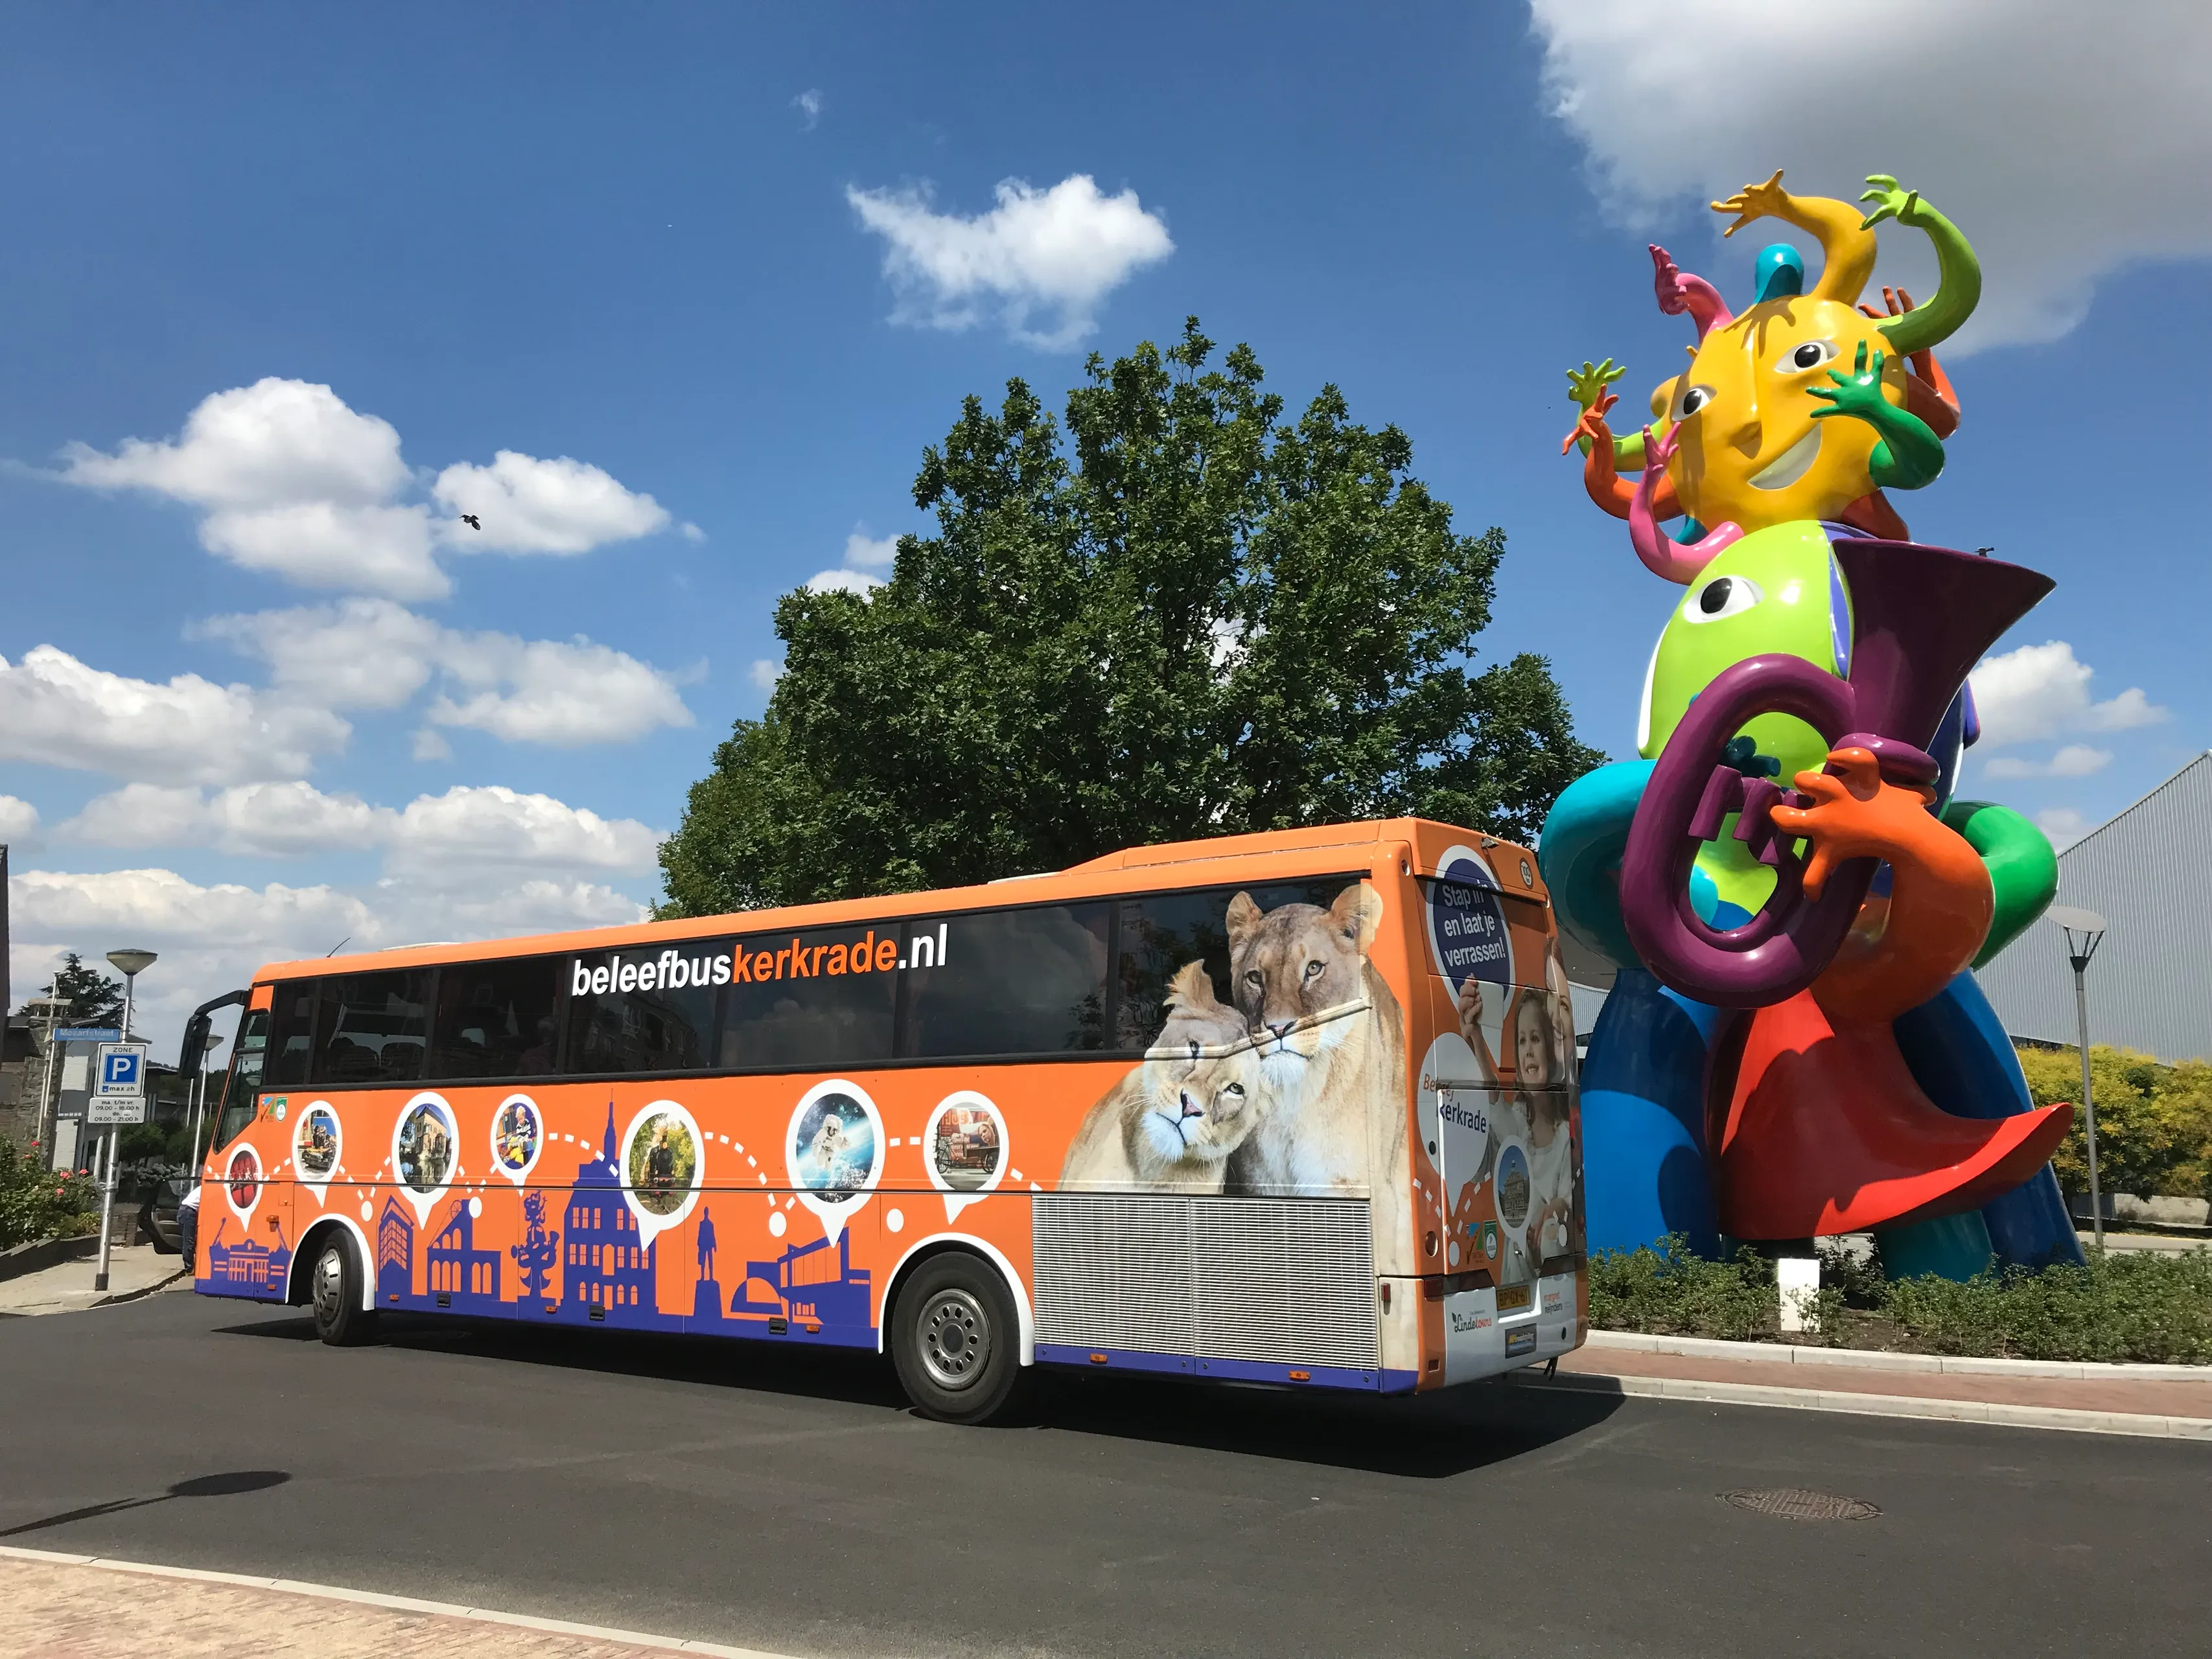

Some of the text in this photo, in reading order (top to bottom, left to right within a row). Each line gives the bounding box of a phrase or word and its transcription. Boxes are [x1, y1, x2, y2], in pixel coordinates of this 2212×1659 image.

[1442, 879, 1488, 911] Stap in
[1444, 910, 1496, 937] en laat je
[572, 923, 948, 997] beleefbuskerkrade.nl
[1445, 937, 1506, 967] verrassen!
